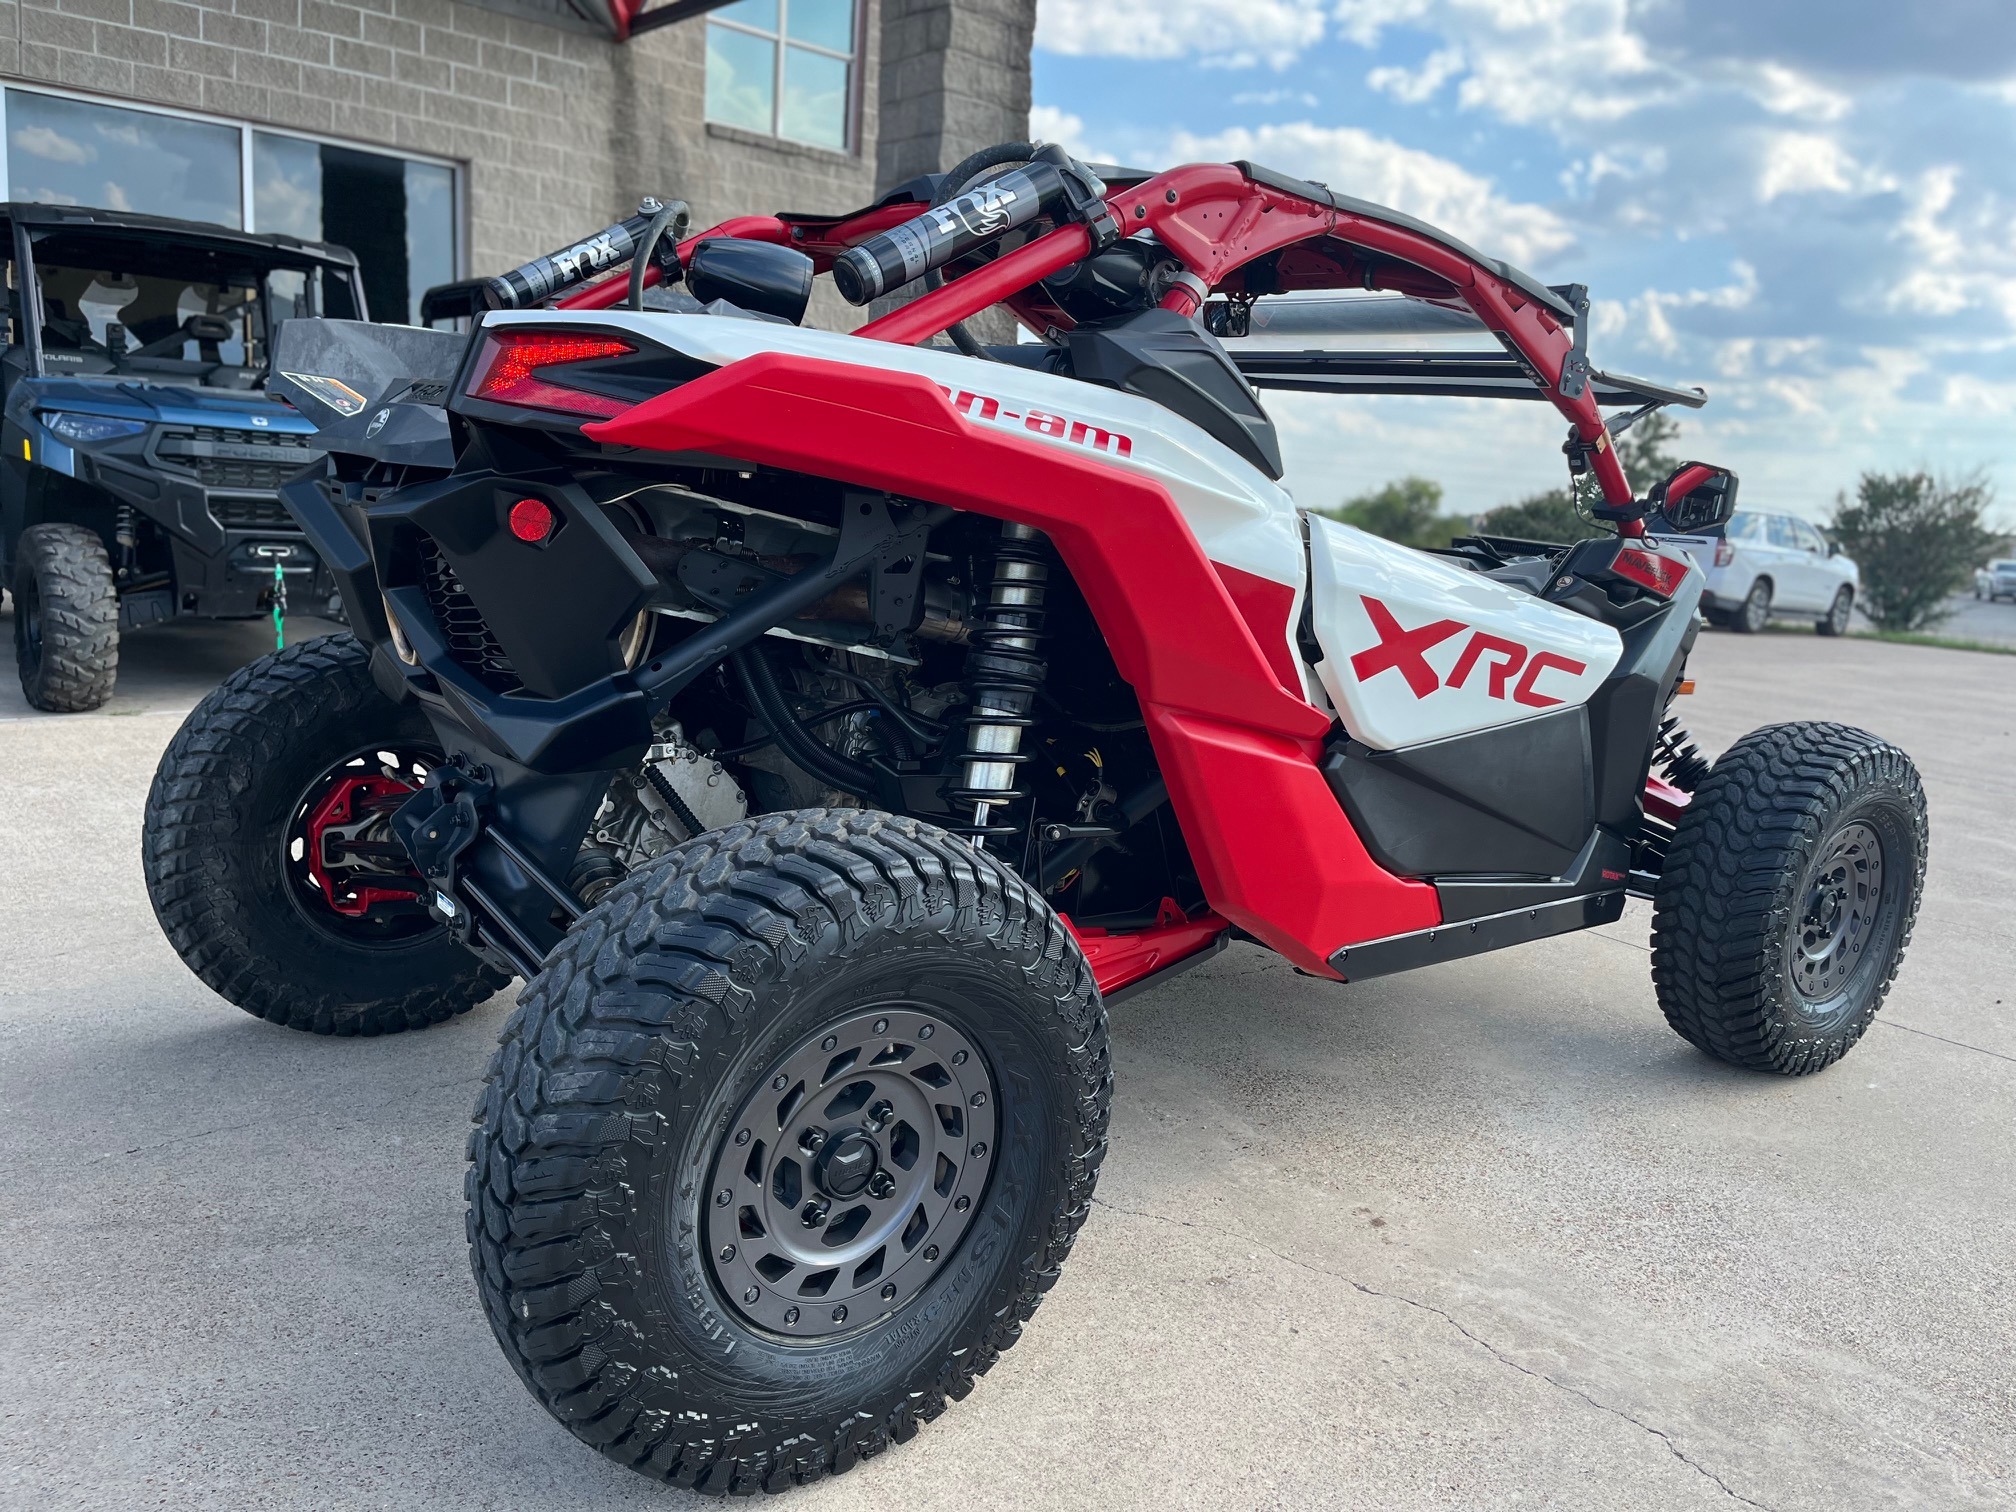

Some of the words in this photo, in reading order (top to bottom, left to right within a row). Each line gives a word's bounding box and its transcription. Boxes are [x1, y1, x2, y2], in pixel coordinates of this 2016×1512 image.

[922, 181, 1018, 236] FOX
[550, 233, 621, 282] FOX
[216, 446, 306, 460] POLARIS
[1350, 594, 1587, 708] XRC
[679, 1219, 737, 1354] LIBERTY
[884, 1314, 922, 1345] RADIAL
